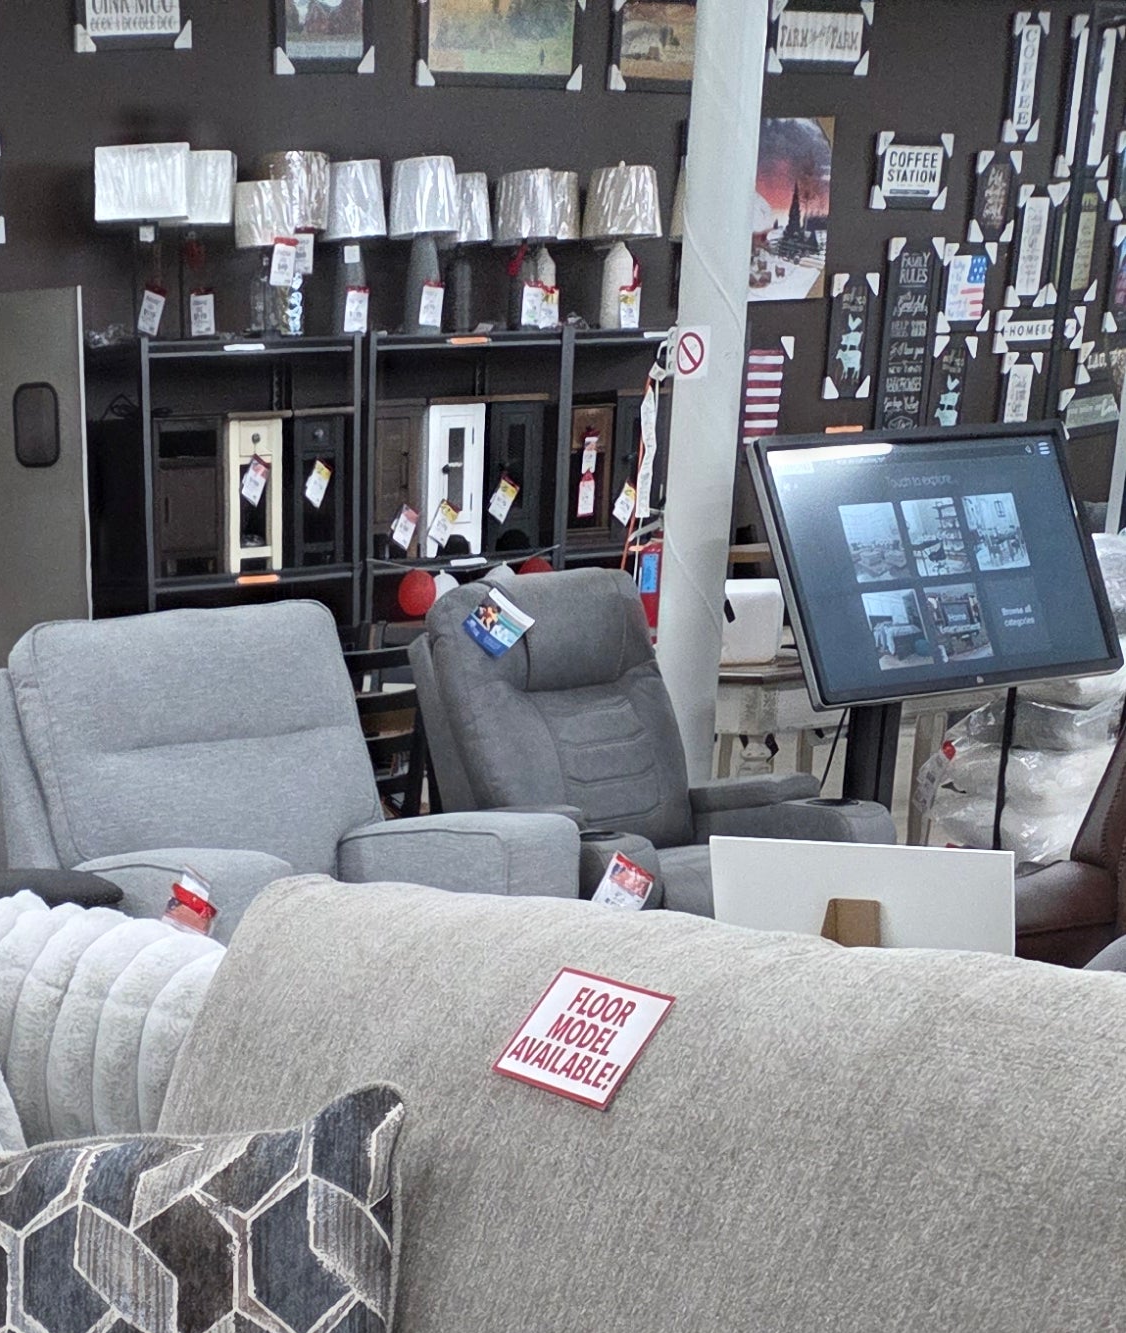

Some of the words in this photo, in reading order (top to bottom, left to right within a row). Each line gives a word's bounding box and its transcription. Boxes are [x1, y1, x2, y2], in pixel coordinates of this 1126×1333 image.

[1016, 28, 1038, 126] COFFEE
[887, 169, 937, 183] STATION
[889, 151, 938, 169] COFFEE
[899, 268, 928, 284] RULES
[567, 987, 636, 1027] FLOOR
[545, 1013, 618, 1056] MODEL
[507, 1036, 621, 1091] AVAILABLE!
